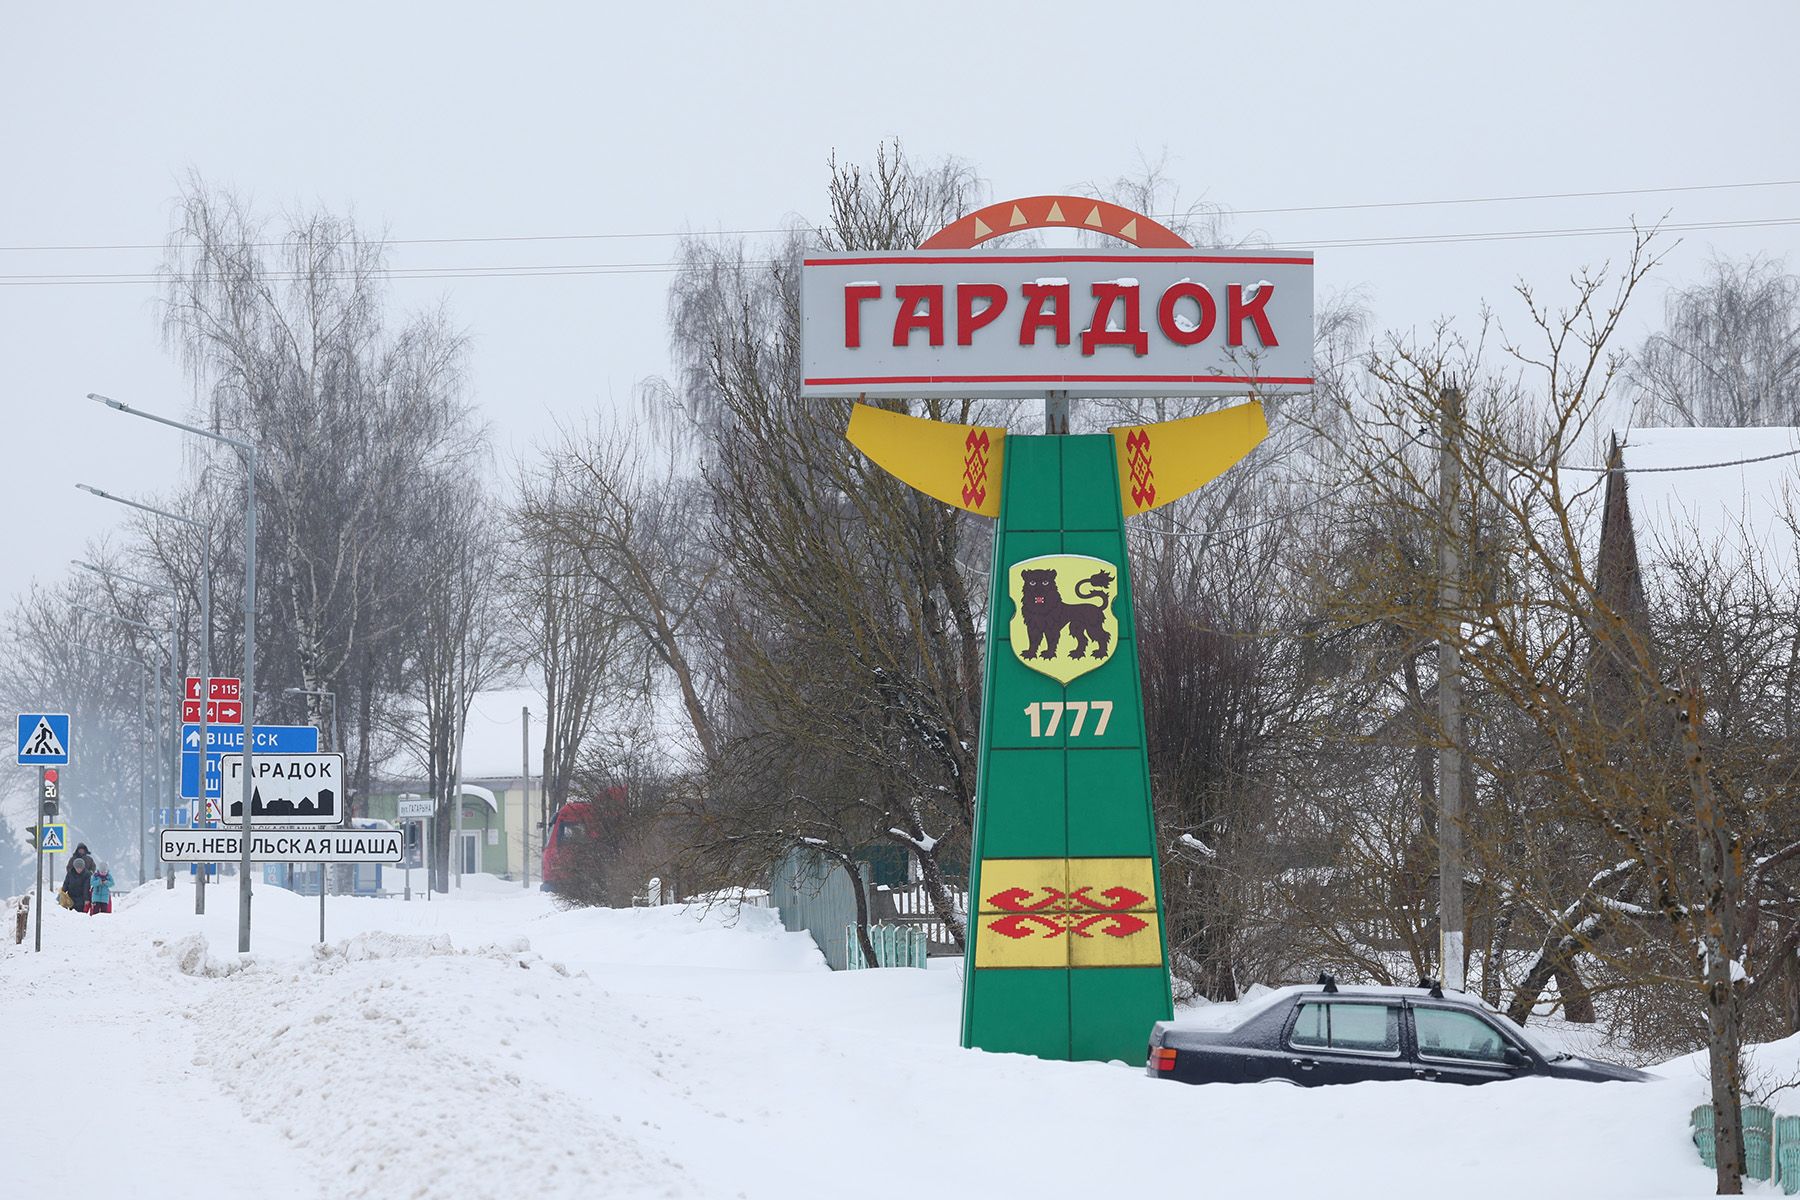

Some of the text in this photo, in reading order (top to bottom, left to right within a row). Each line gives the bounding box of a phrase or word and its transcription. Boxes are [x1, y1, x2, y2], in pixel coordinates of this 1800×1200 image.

[844, 281, 1279, 356] ГАРАДОК
[221, 684, 238, 695] 115
[197, 707, 214, 717] 14
[1024, 701, 1113, 737] 1777
